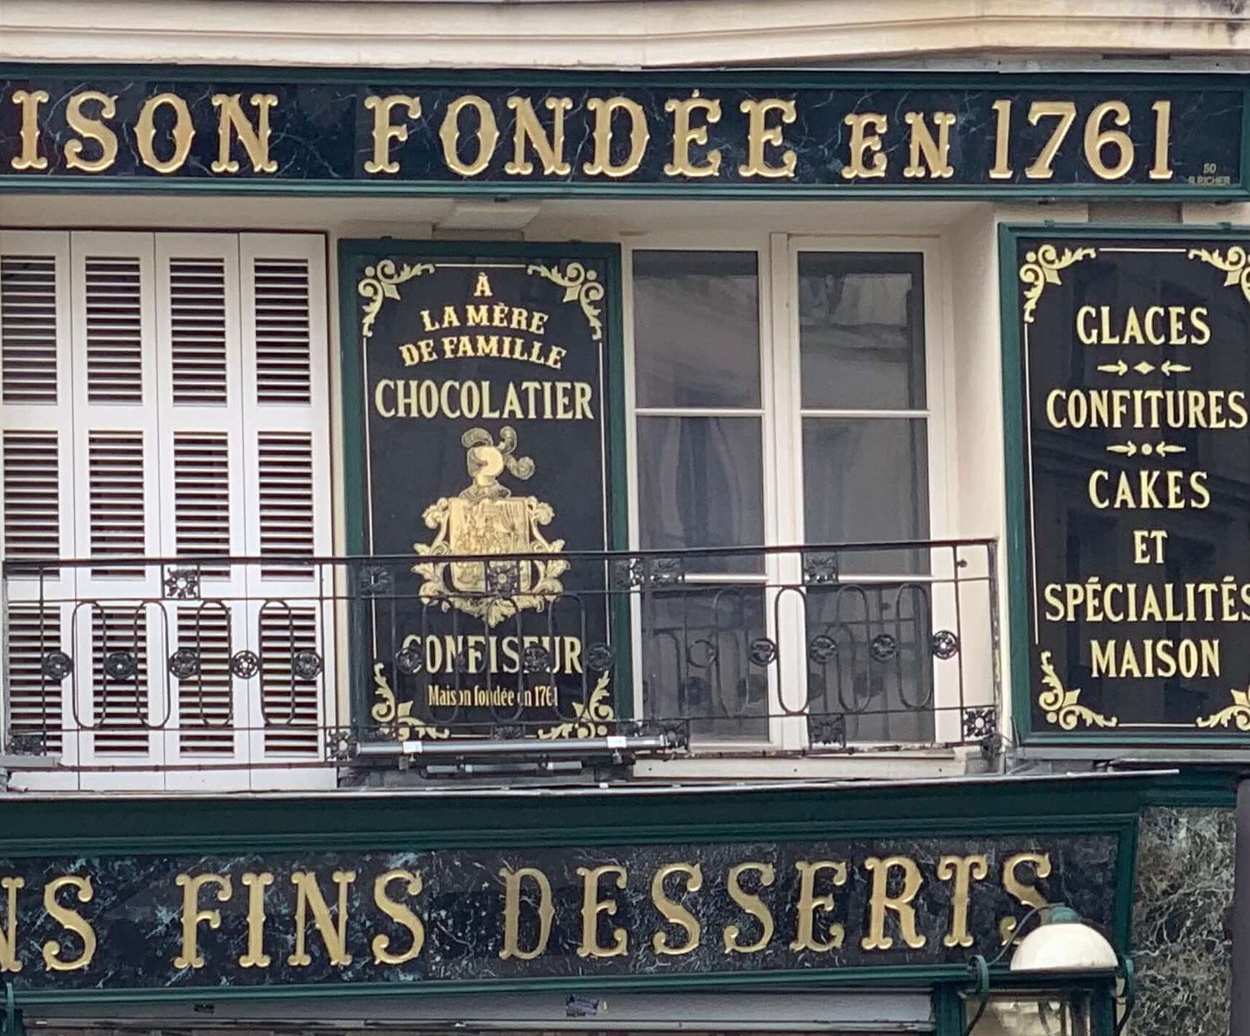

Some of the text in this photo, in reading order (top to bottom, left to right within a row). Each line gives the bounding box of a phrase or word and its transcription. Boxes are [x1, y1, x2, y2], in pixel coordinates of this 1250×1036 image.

[363, 89, 797, 178] FONDÉE
[841, 111, 956, 179] EN
[989, 99, 1173, 180] 1761
[474, 272, 493, 297] À
[420, 302, 549, 335] LA MÈRE
[1076, 305, 1211, 345] GLACES
[399, 335, 567, 370] DE FAMILLE
[374, 379, 594, 421] CHOCOLATIER
[1046, 389, 1248, 429] CONFITURES
[1088, 469, 1211, 509] CAKES
[1133, 529, 1168, 564] ET
[1090, 638, 1220, 678] MAISON
[174, 869, 425, 970] FINS
[498, 851, 1051, 960] DESSERTS
